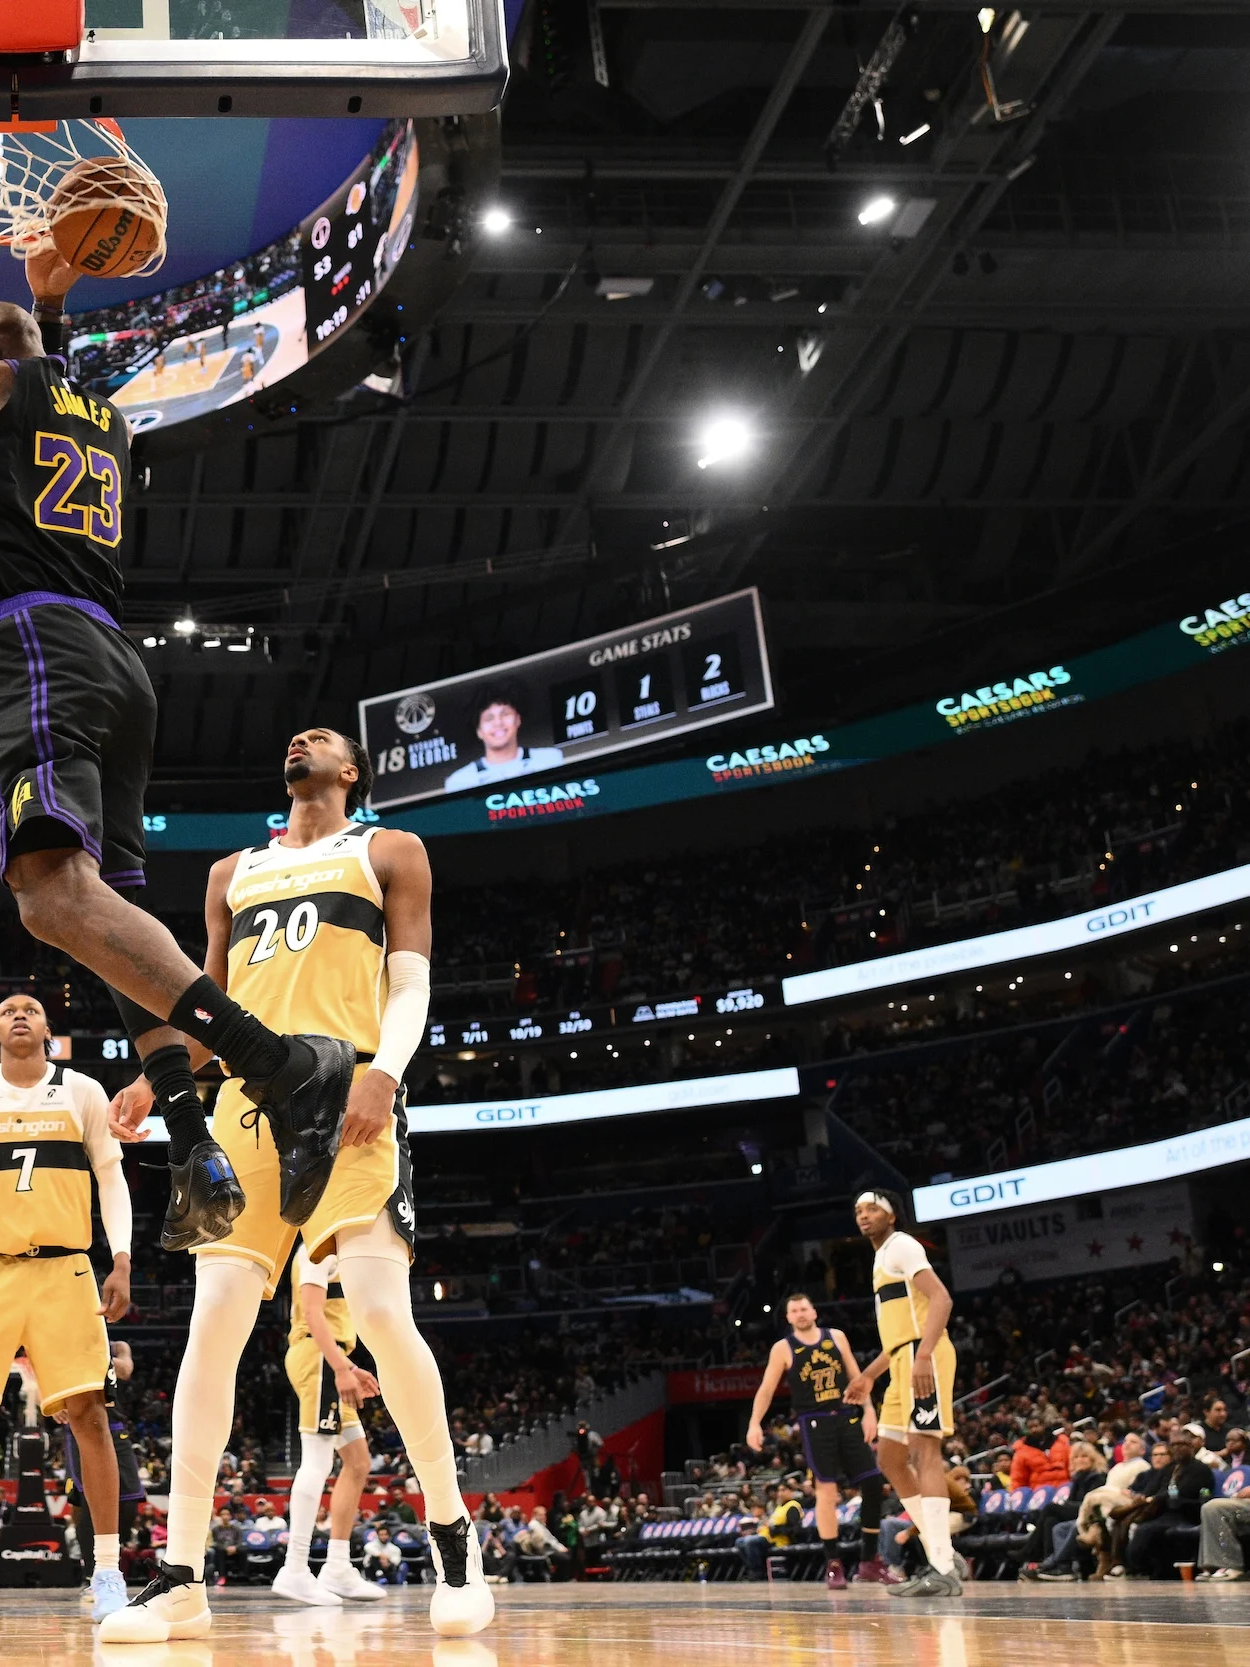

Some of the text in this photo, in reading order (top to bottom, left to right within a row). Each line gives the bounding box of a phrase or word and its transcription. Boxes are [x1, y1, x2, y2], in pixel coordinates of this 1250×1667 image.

[80, 209, 135, 272] Wilson
[50, 386, 112, 433] JAMES
[34, 431, 123, 549] 23
[589, 622, 692, 667] GAME STATS
[702, 653, 722, 681] 2
[639, 673, 651, 700] 1
[935, 665, 1071, 716] CAESARS
[565, 690, 597, 721] 10
[945, 687, 1056, 728] SPORTSBOOK
[377, 745, 406, 776] 18
[706, 735, 830, 772] CAESARS
[712, 754, 815, 783] SPORTSBOOK
[485, 778, 600, 811] CAESARS
[488, 797, 585, 821] SPORTSBOOK
[234, 868, 345, 904] washington
[247, 901, 319, 966] 20
[1086, 901, 1156, 934] GDIT
[102, 1039, 129, 1060] 81
[475, 1105, 542, 1123] GDIT
[11, 1148, 38, 1192] 7
[950, 1177, 1026, 1208] GDIT
[985, 1211, 1066, 1246] VAULTS
[810, 1367, 836, 1392] 77
